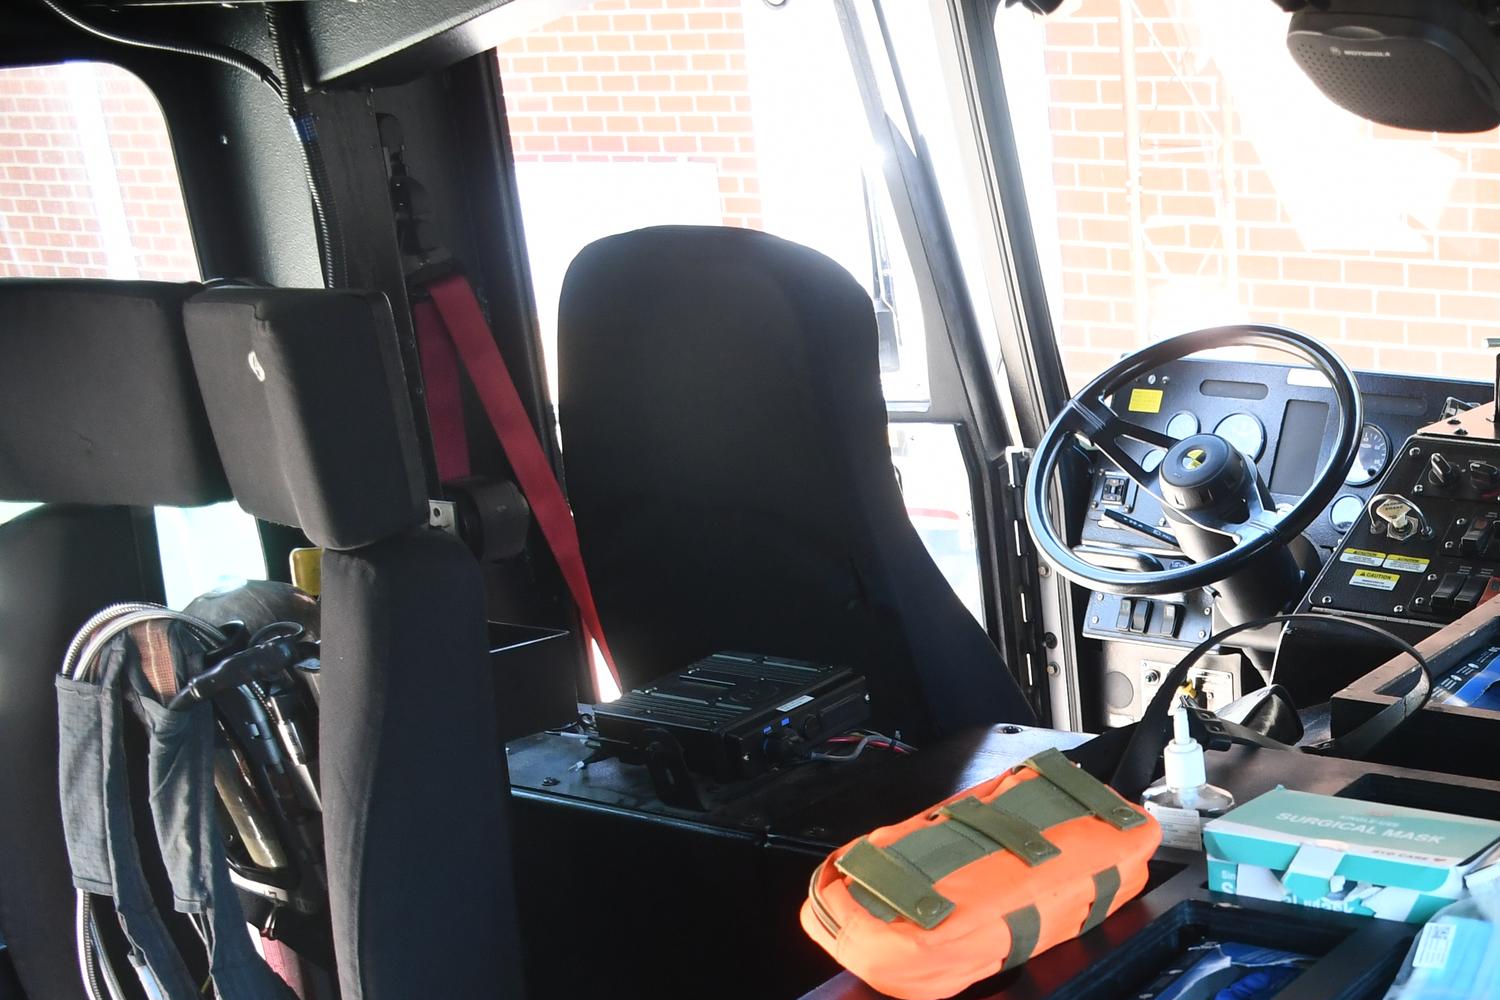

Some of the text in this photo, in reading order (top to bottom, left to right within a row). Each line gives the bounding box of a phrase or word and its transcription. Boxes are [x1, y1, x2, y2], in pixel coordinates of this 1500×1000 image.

[1366, 572, 1392, 580] CAUTION
[1275, 812, 1446, 844] SURGICAL MASK
